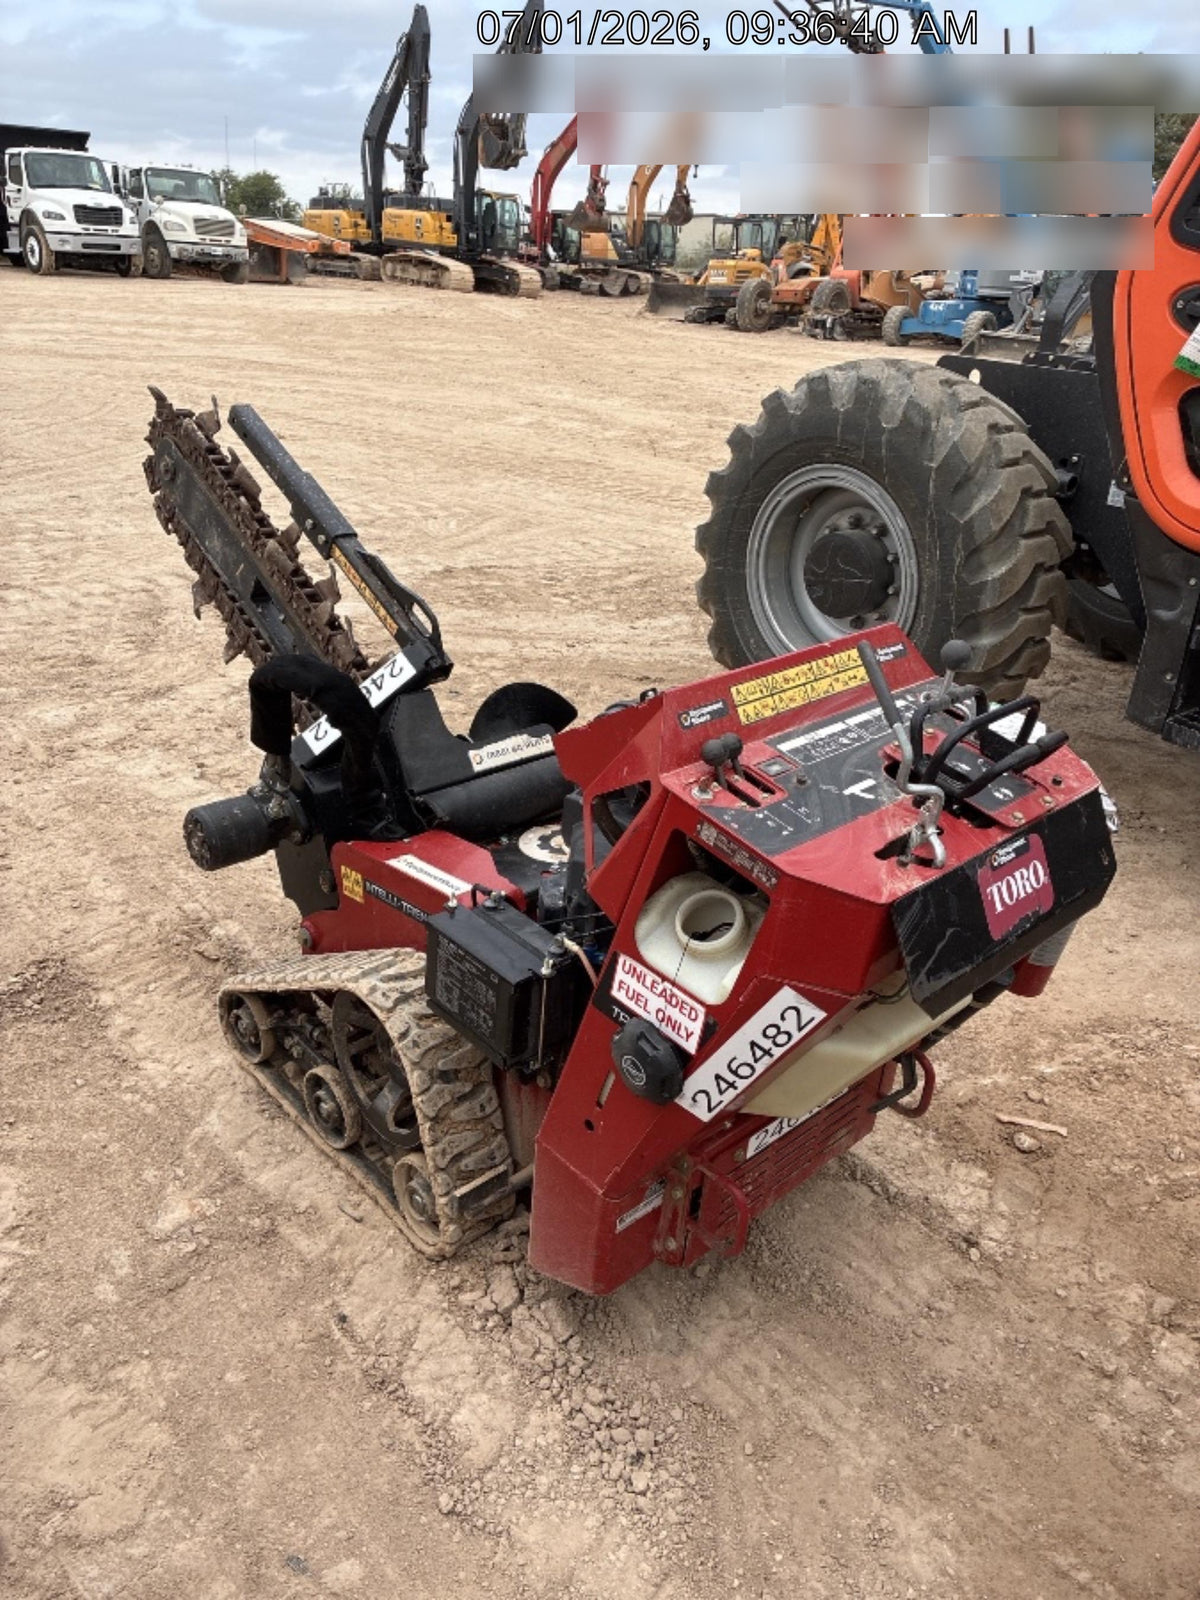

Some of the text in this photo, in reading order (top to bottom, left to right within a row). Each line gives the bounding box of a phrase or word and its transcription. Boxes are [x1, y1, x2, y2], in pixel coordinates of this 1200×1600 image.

[986, 860, 1046, 914] TORO
[618, 980, 694, 1043] FUEL ONLY
[622, 959, 699, 1022] UNLEADED
[691, 1006, 815, 1114] 246482
